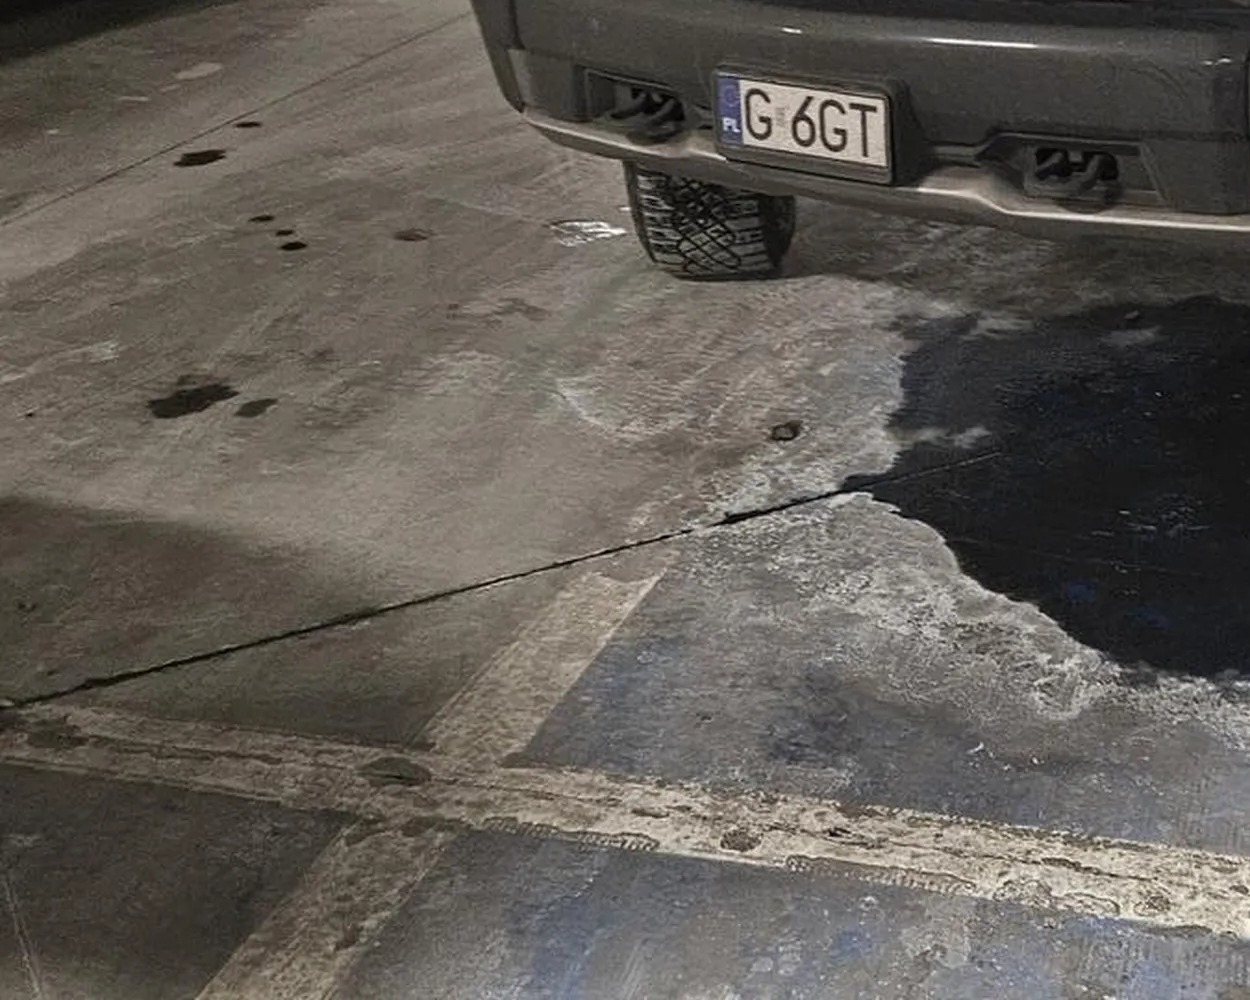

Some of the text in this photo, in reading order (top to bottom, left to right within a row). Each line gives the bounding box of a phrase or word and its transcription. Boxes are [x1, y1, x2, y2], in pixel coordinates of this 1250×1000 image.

[723, 117, 741, 133] PL
[744, 88, 878, 158] G 6GT
